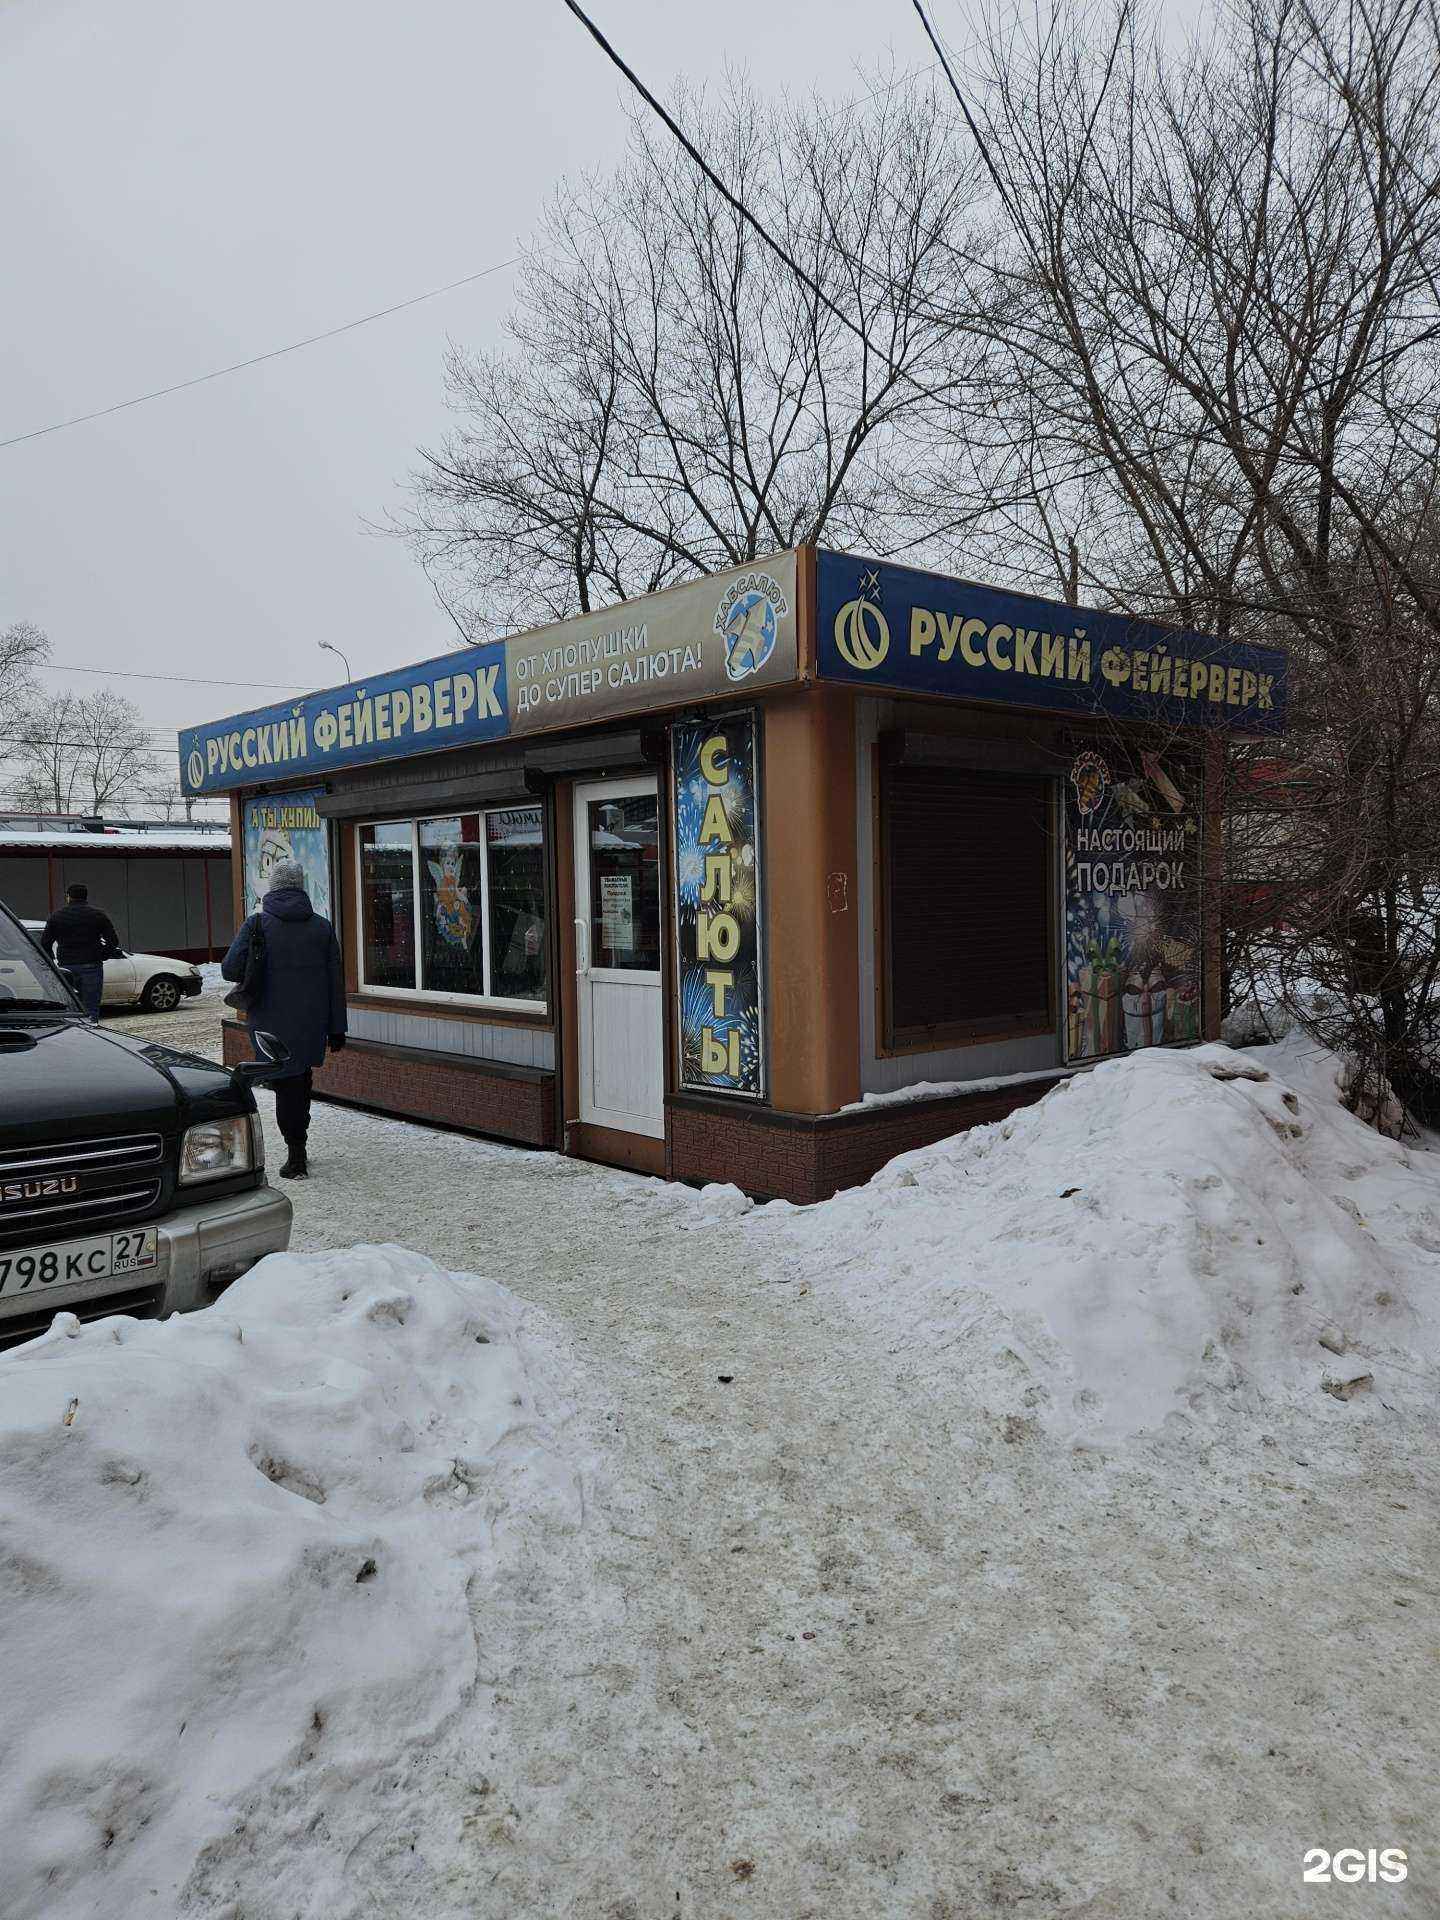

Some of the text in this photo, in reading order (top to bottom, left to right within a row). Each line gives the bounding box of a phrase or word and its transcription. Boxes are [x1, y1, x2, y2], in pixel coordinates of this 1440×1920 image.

[715, 574, 787, 634] ХАБСАЛЮТ
[515, 624, 649, 681] ОТ ХЛОПУШКИ
[516, 642, 703, 713] ДО СУПЕР САЛЮТА!
[909, 607, 1275, 710] РУССКИЙ ФЕЙЕРВЕРК
[205, 663, 503, 776] РУССКИЙ ФЕЙЕРВЕРК
[251, 807, 259, 828] А
[261, 807, 277, 828] ТЫ
[1077, 825, 1185, 855] НАСТОЯЩИЙ
[695, 735, 741, 1078] САЛЮТЫ
[1076, 861, 1185, 897] ПОДАРОК
[114, 1257, 138, 1270] RUS
[116, 1232, 146, 1260] 27
